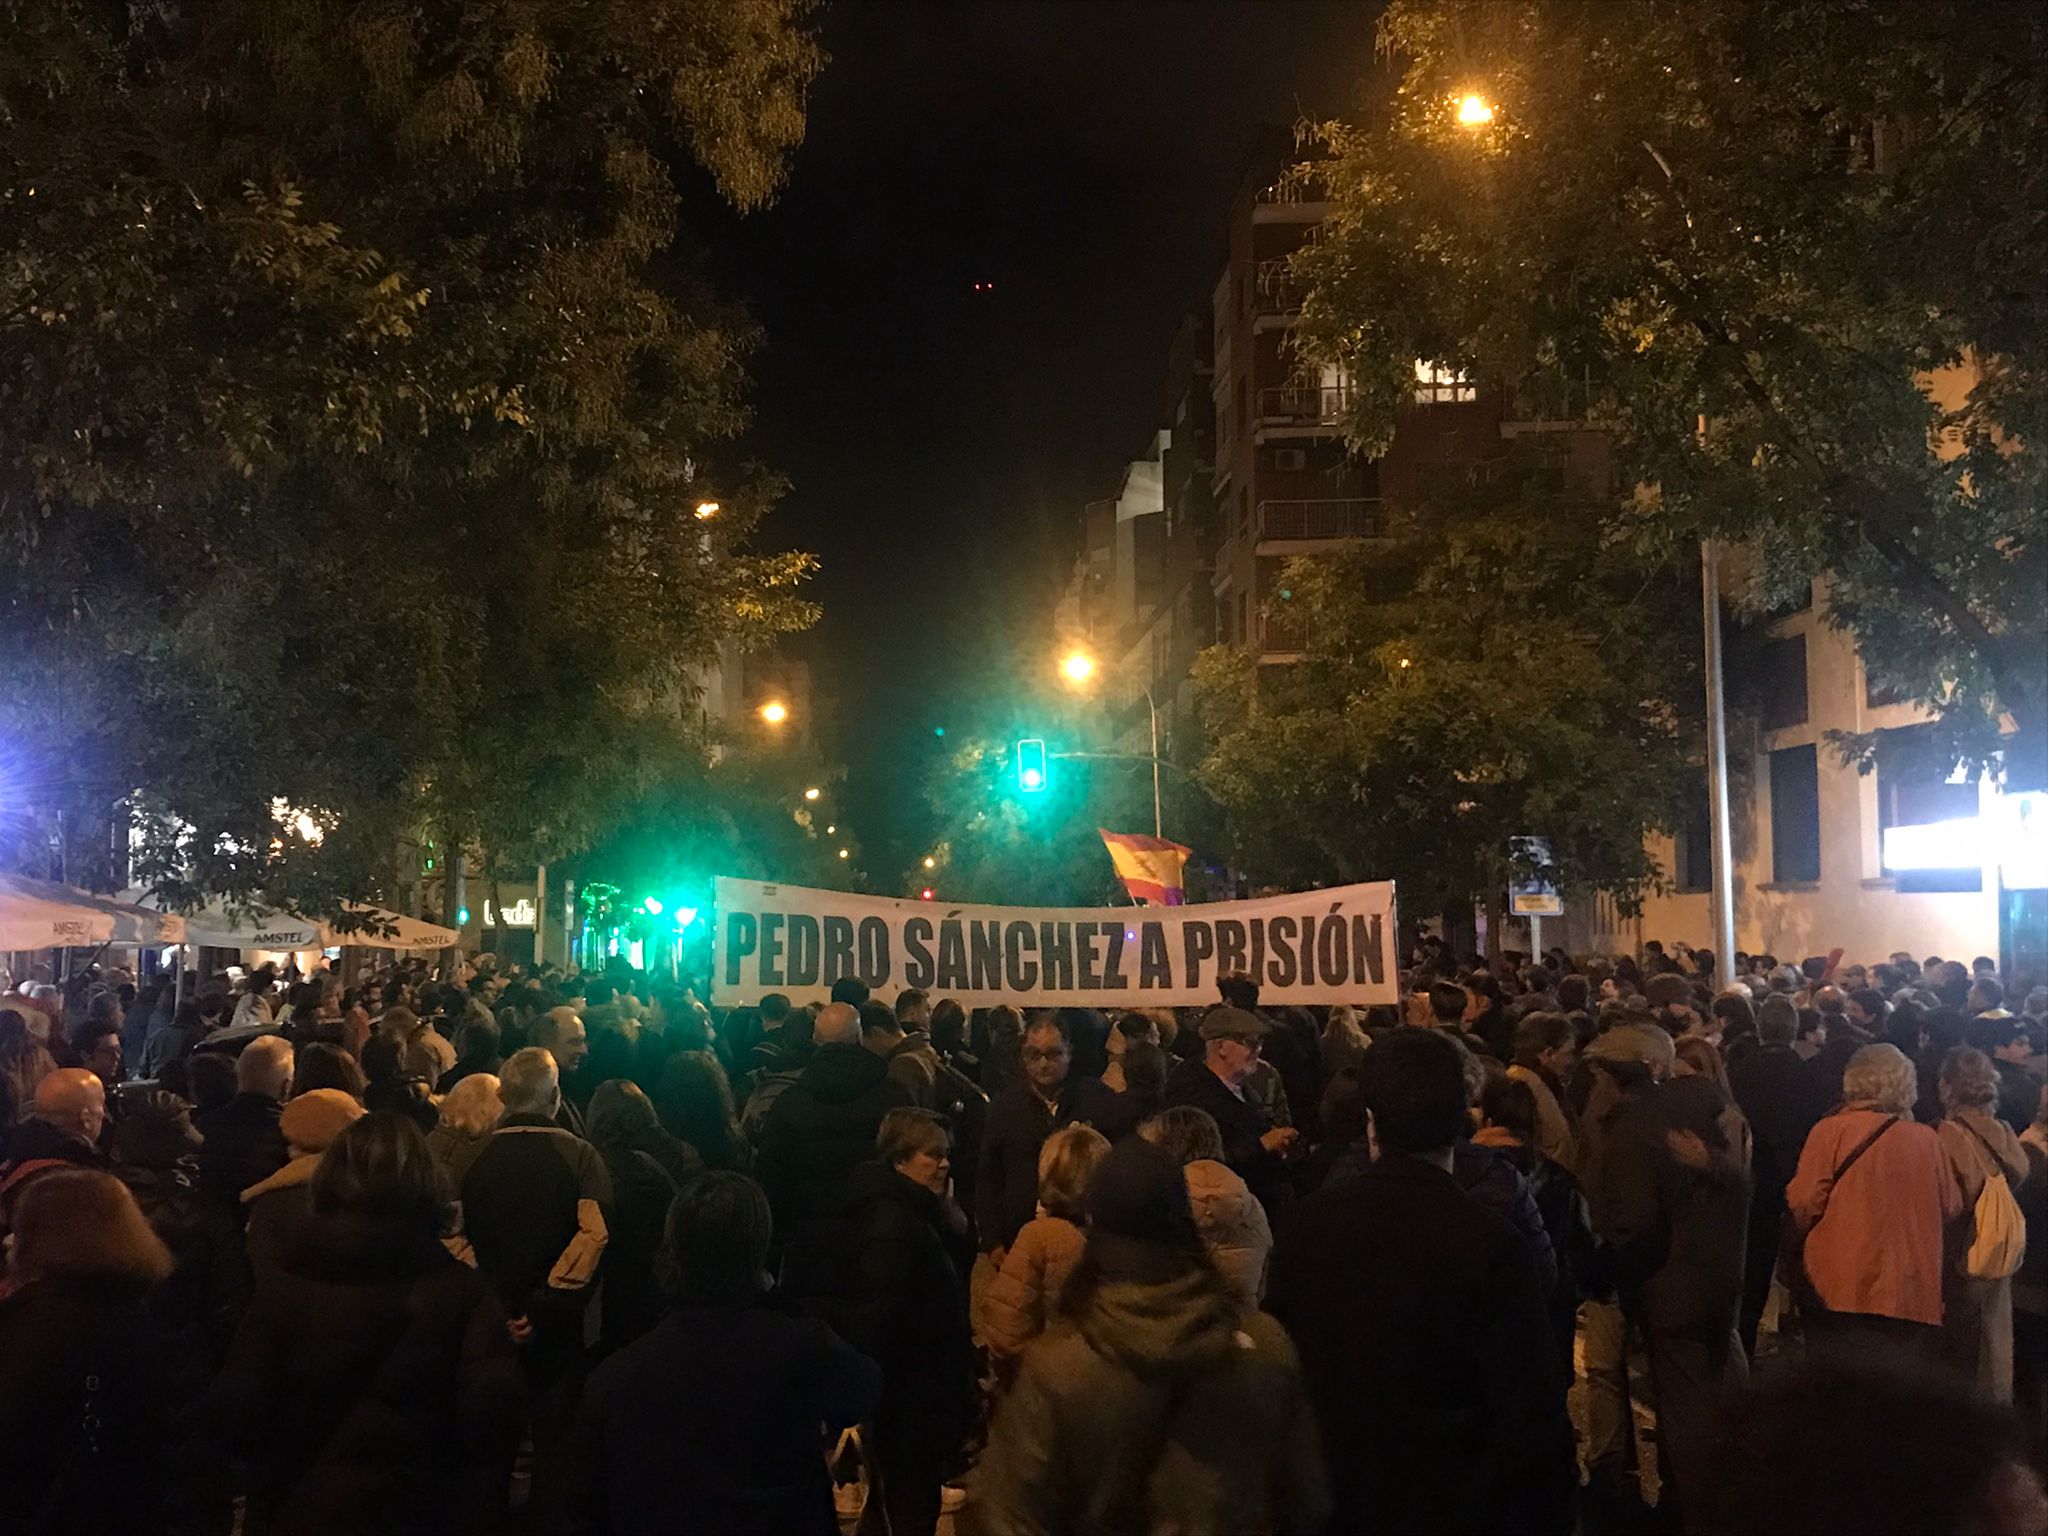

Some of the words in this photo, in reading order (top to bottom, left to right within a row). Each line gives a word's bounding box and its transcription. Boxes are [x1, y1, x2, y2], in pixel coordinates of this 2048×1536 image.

[253, 932, 304, 944] AMSTEL
[412, 935, 451, 946] AMSTEL
[726, 912, 890, 989] PEDRO
[904, 910, 1128, 992] SÁNCHEZ
[1139, 921, 1172, 989] A
[1183, 902, 1385, 989] PRISIÓN
